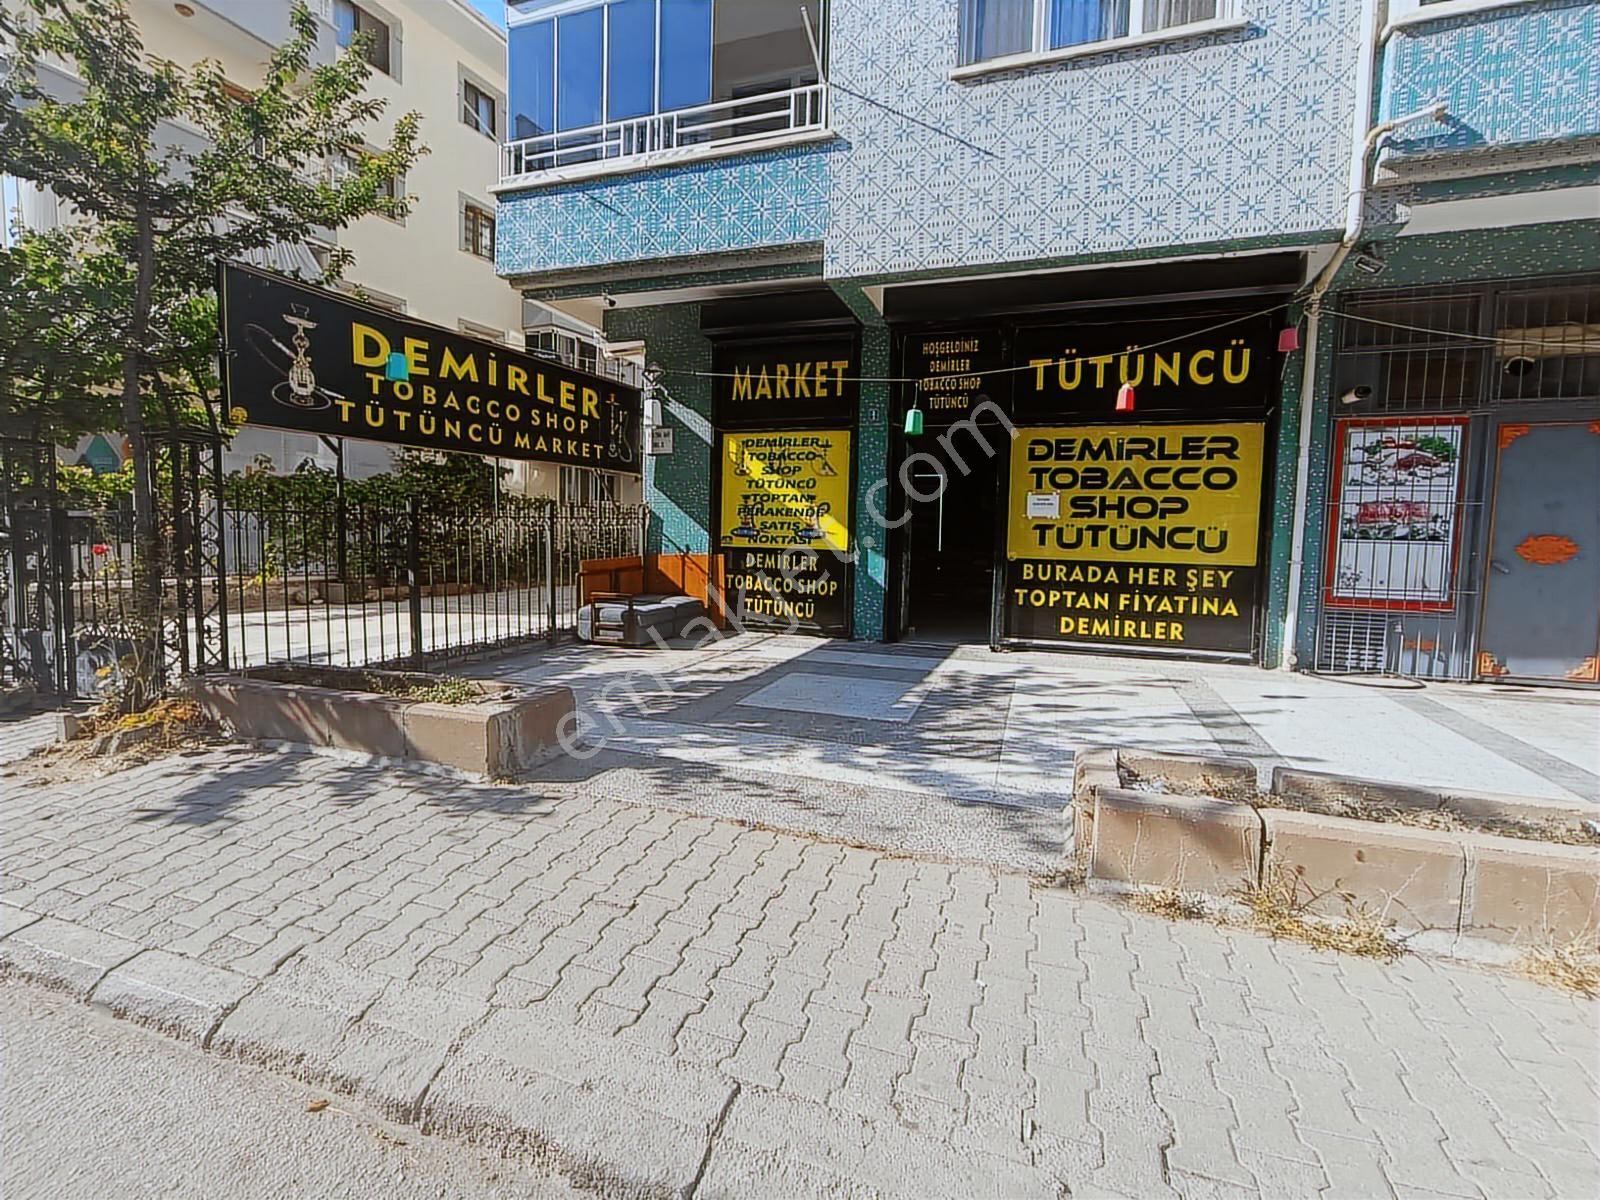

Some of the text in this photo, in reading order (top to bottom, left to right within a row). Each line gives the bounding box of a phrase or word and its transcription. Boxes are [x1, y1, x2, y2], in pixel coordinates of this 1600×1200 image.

[352, 321, 600, 419] DEMİRLER
[929, 357, 970, 373] DEMİRLER
[1029, 339, 1251, 391] TÜTÜNCÜ
[732, 360, 849, 401] MARKET
[918, 377, 981, 391] TOBACCO SHOP
[365, 372, 589, 434] TOBACCO SHOP
[929, 392, 969, 409] TÜTÜNCÜ
[334, 399, 604, 460] TÜTÜNCÜ MARKET
[744, 436, 822, 448] DEMİRLER
[747, 450, 817, 461] TOBACCO
[1027, 435, 1240, 462] DEMİRLER
[762, 465, 802, 475] SHOP
[1028, 466, 1239, 491] TOBACCO
[746, 478, 817, 490] TÜTÜNCÜ
[751, 493, 812, 504] TOPTAN
[1068, 495, 1190, 520] SHOP
[737, 506, 826, 518] PERAKENDE
[1031, 522, 1229, 554] TÜTÜNCÜ
[745, 550, 818, 572] DEMİRLER
[725, 573, 838, 596] TOBACCO SHOP
[1023, 564, 1235, 592] BURADA HER ŞEY
[744, 594, 815, 619] TÜTÜNCÜ
[1015, 587, 1240, 617] TOPTAN FİYATINA
[1059, 615, 1186, 641] DEMİRLER
